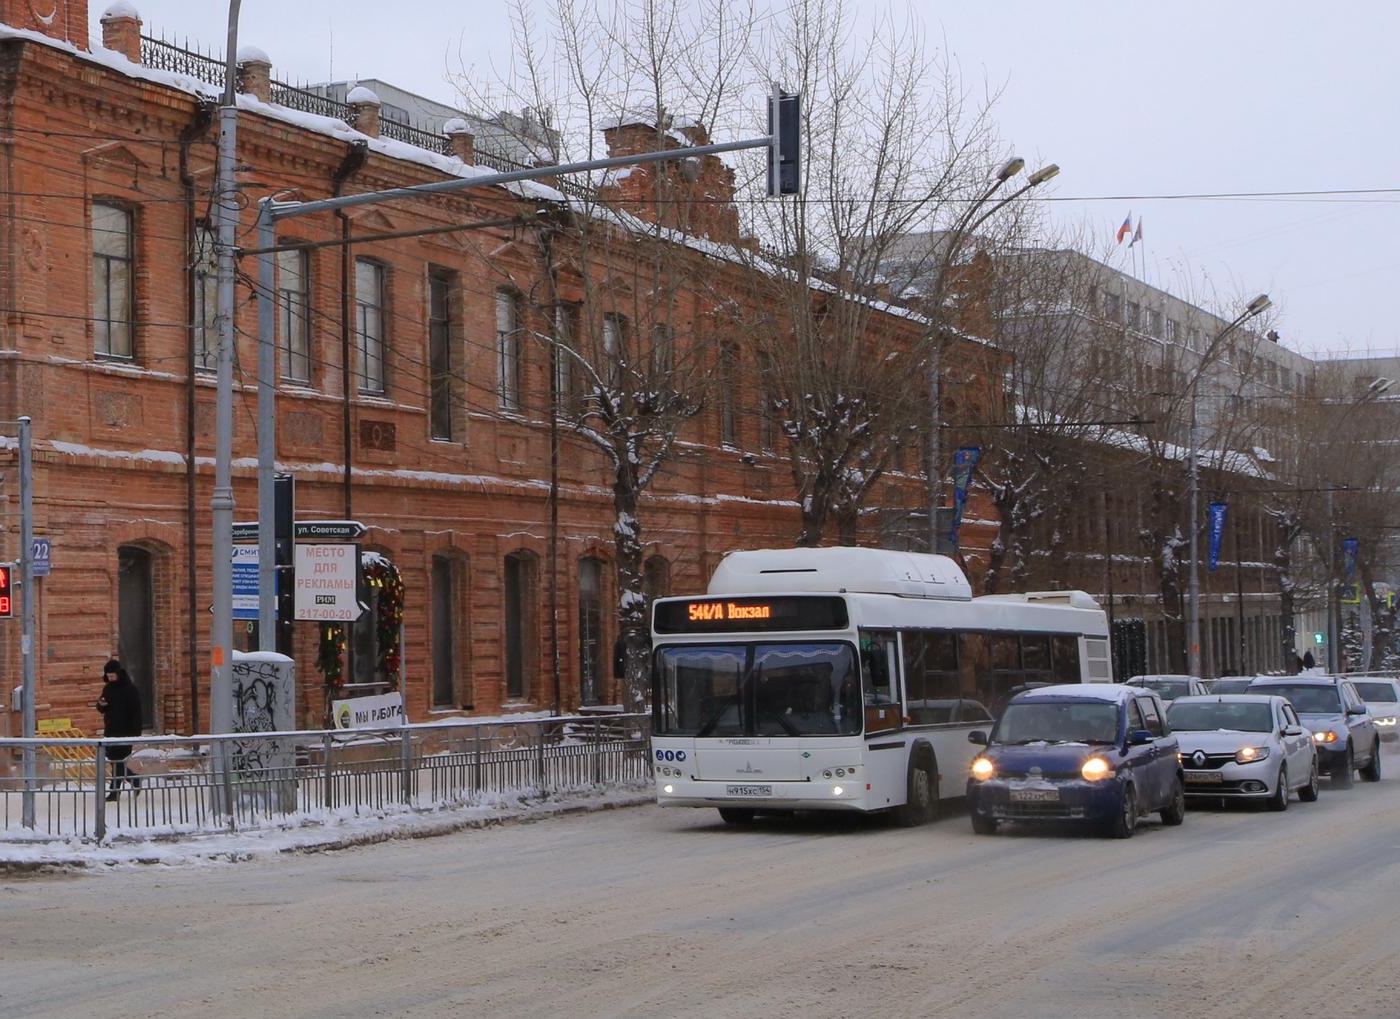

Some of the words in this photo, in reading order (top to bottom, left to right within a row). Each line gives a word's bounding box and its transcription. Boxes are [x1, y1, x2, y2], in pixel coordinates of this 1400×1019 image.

[297, 527, 309, 535] ул.
[310, 525, 350, 534] Советская
[34, 543, 49, 560] 22
[240, 549, 260, 557] СМИ
[306, 547, 345, 558] МЕСТО
[314, 563, 337, 574] ДЛЯ
[297, 579, 354, 590] РЕКЛАМЫ
[300, 608, 352, 620] 217-00-20
[727, 602, 770, 619] Вокзал
[355, 710, 369, 724] МЫ
